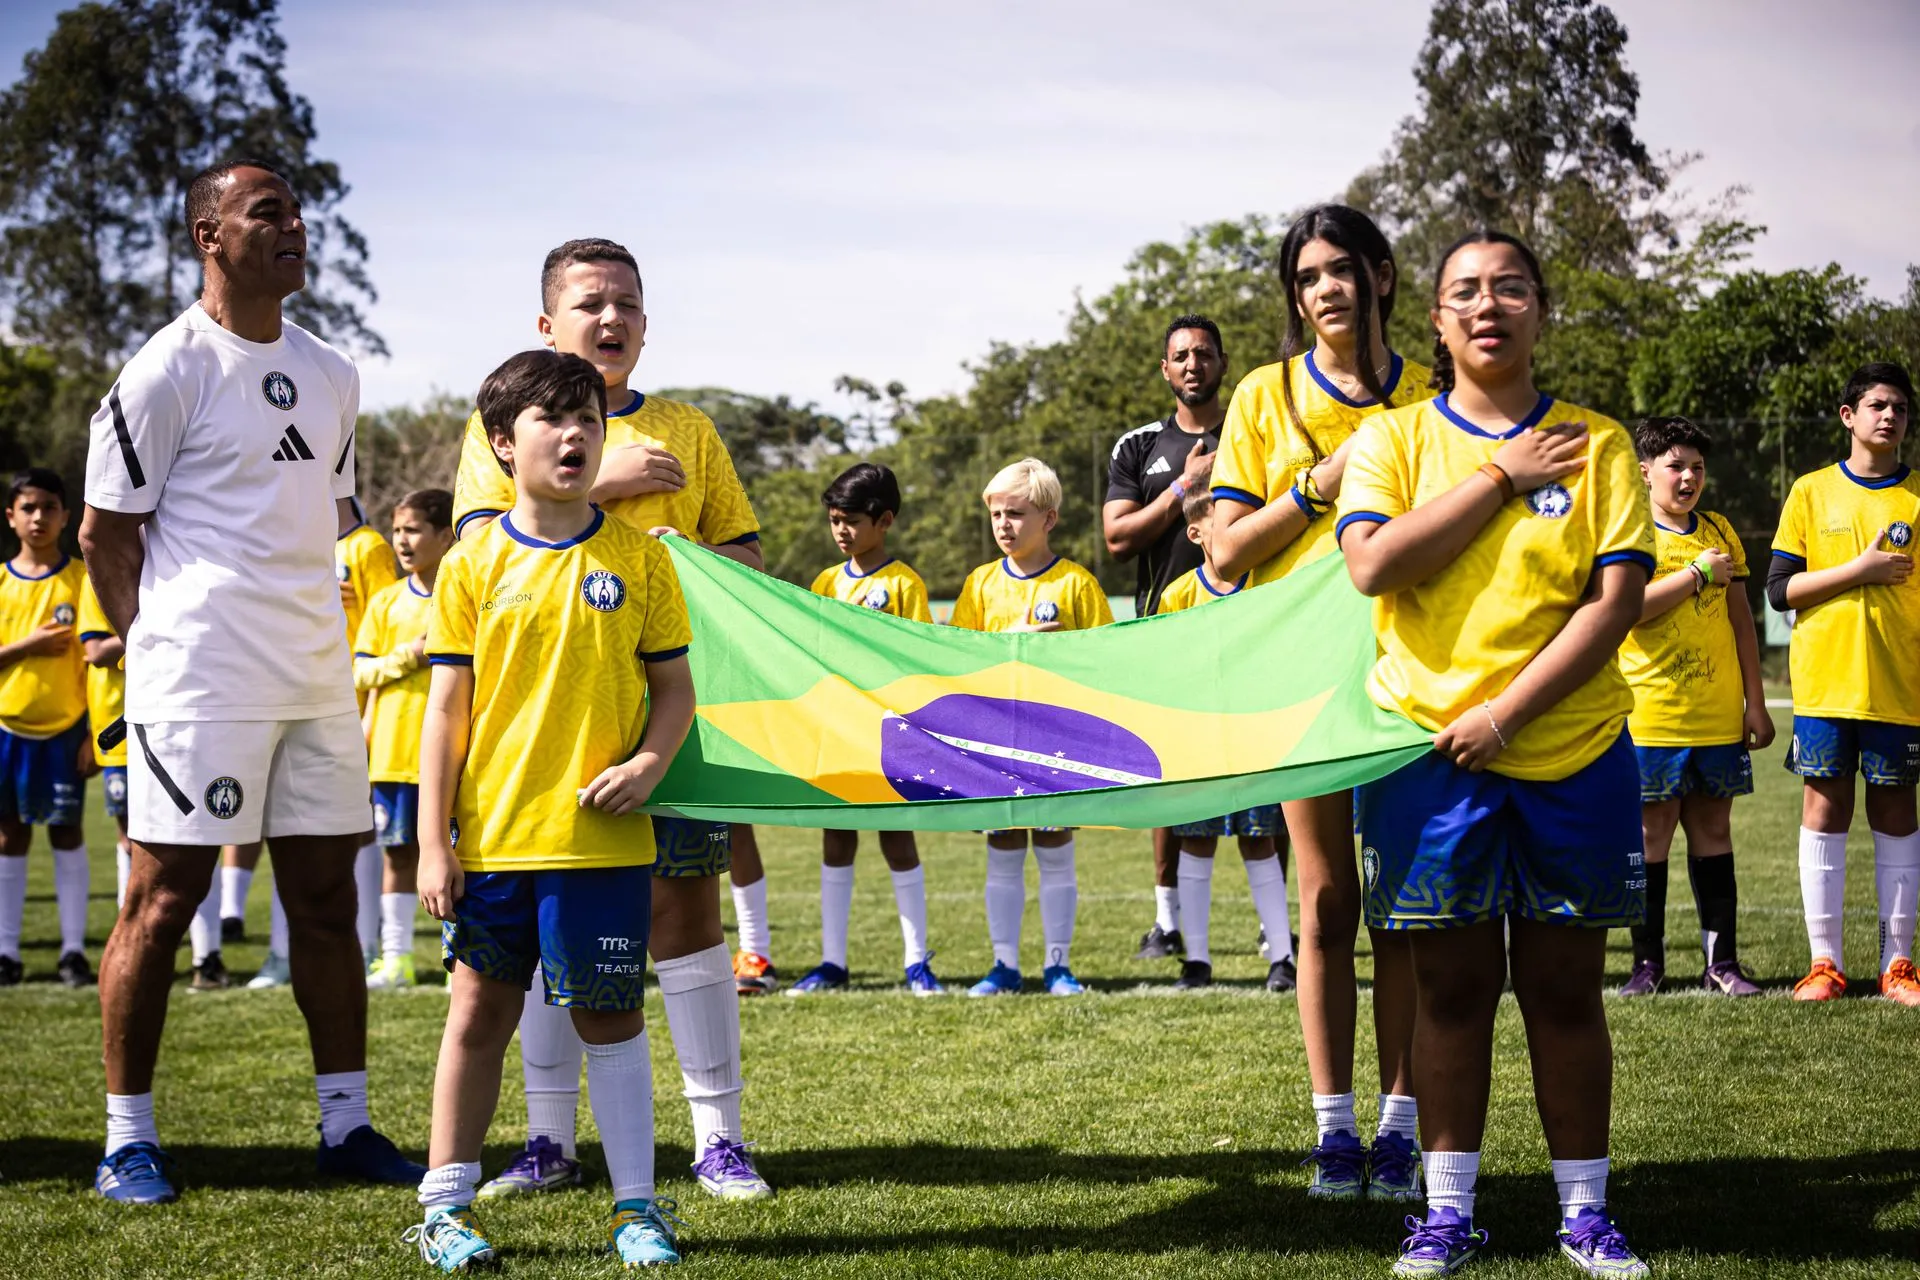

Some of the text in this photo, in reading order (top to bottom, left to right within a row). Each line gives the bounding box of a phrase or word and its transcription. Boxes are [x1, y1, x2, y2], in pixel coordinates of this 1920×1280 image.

[1283, 456, 1316, 467] BOURB
[592, 571, 612, 579] CAFU
[480, 593, 533, 611] BOURBON
[594, 602, 615, 610] CAMP
